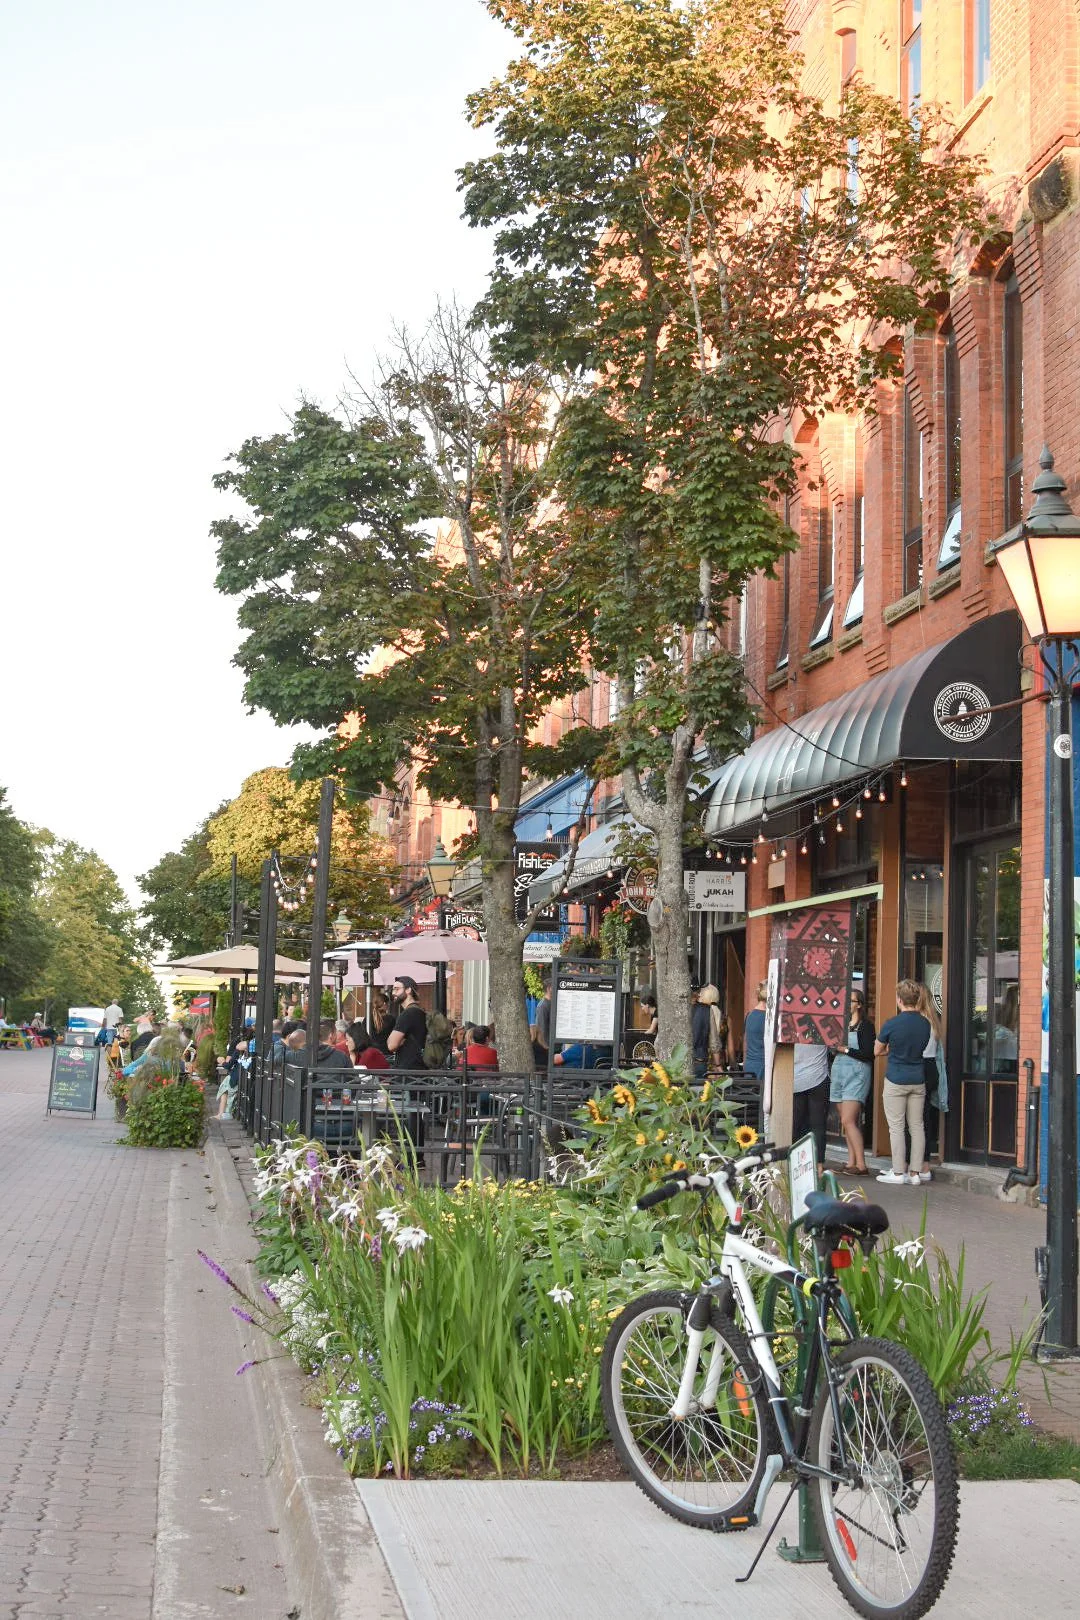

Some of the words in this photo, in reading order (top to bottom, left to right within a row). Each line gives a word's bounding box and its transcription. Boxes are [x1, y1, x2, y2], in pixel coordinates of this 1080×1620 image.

[626, 886, 644, 897] JOHN
[703, 888, 734, 898] JUKAH
[757, 1254, 774, 1266] LASER
